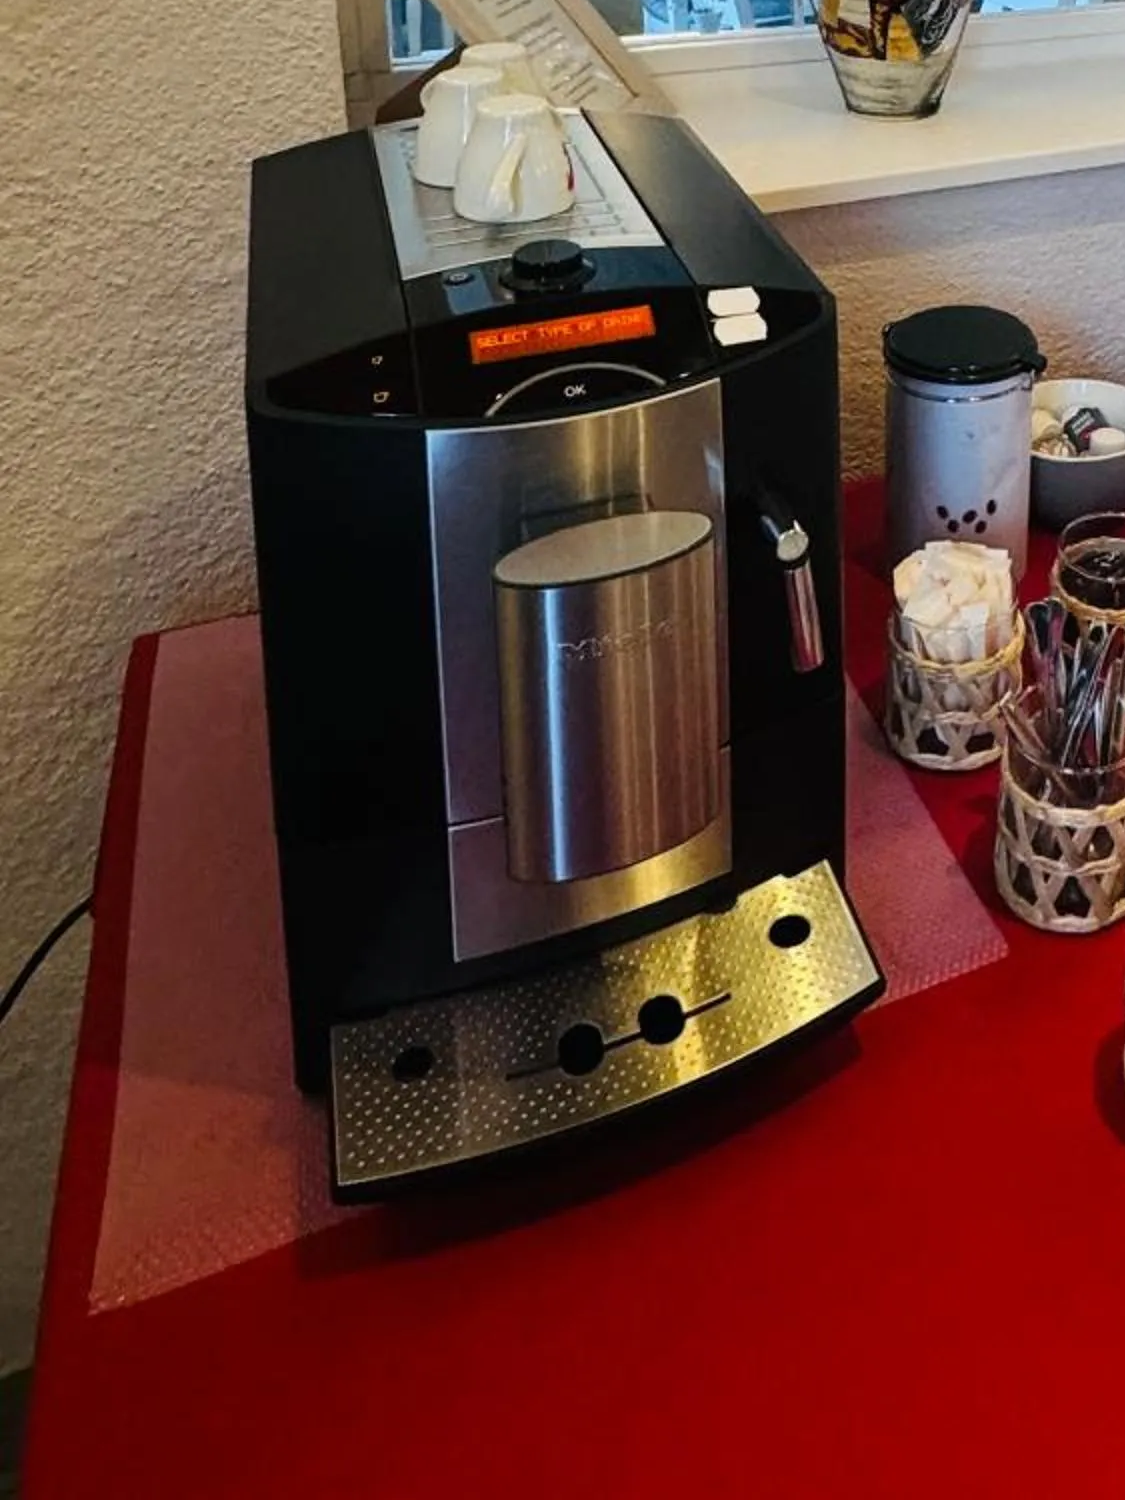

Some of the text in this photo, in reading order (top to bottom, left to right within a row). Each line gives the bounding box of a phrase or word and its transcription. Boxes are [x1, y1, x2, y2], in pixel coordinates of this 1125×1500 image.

[477, 330, 528, 349] SELECT
[539, 323, 573, 338] TYPE
[578, 319, 597, 332] OF
[563, 384, 587, 398] OK
